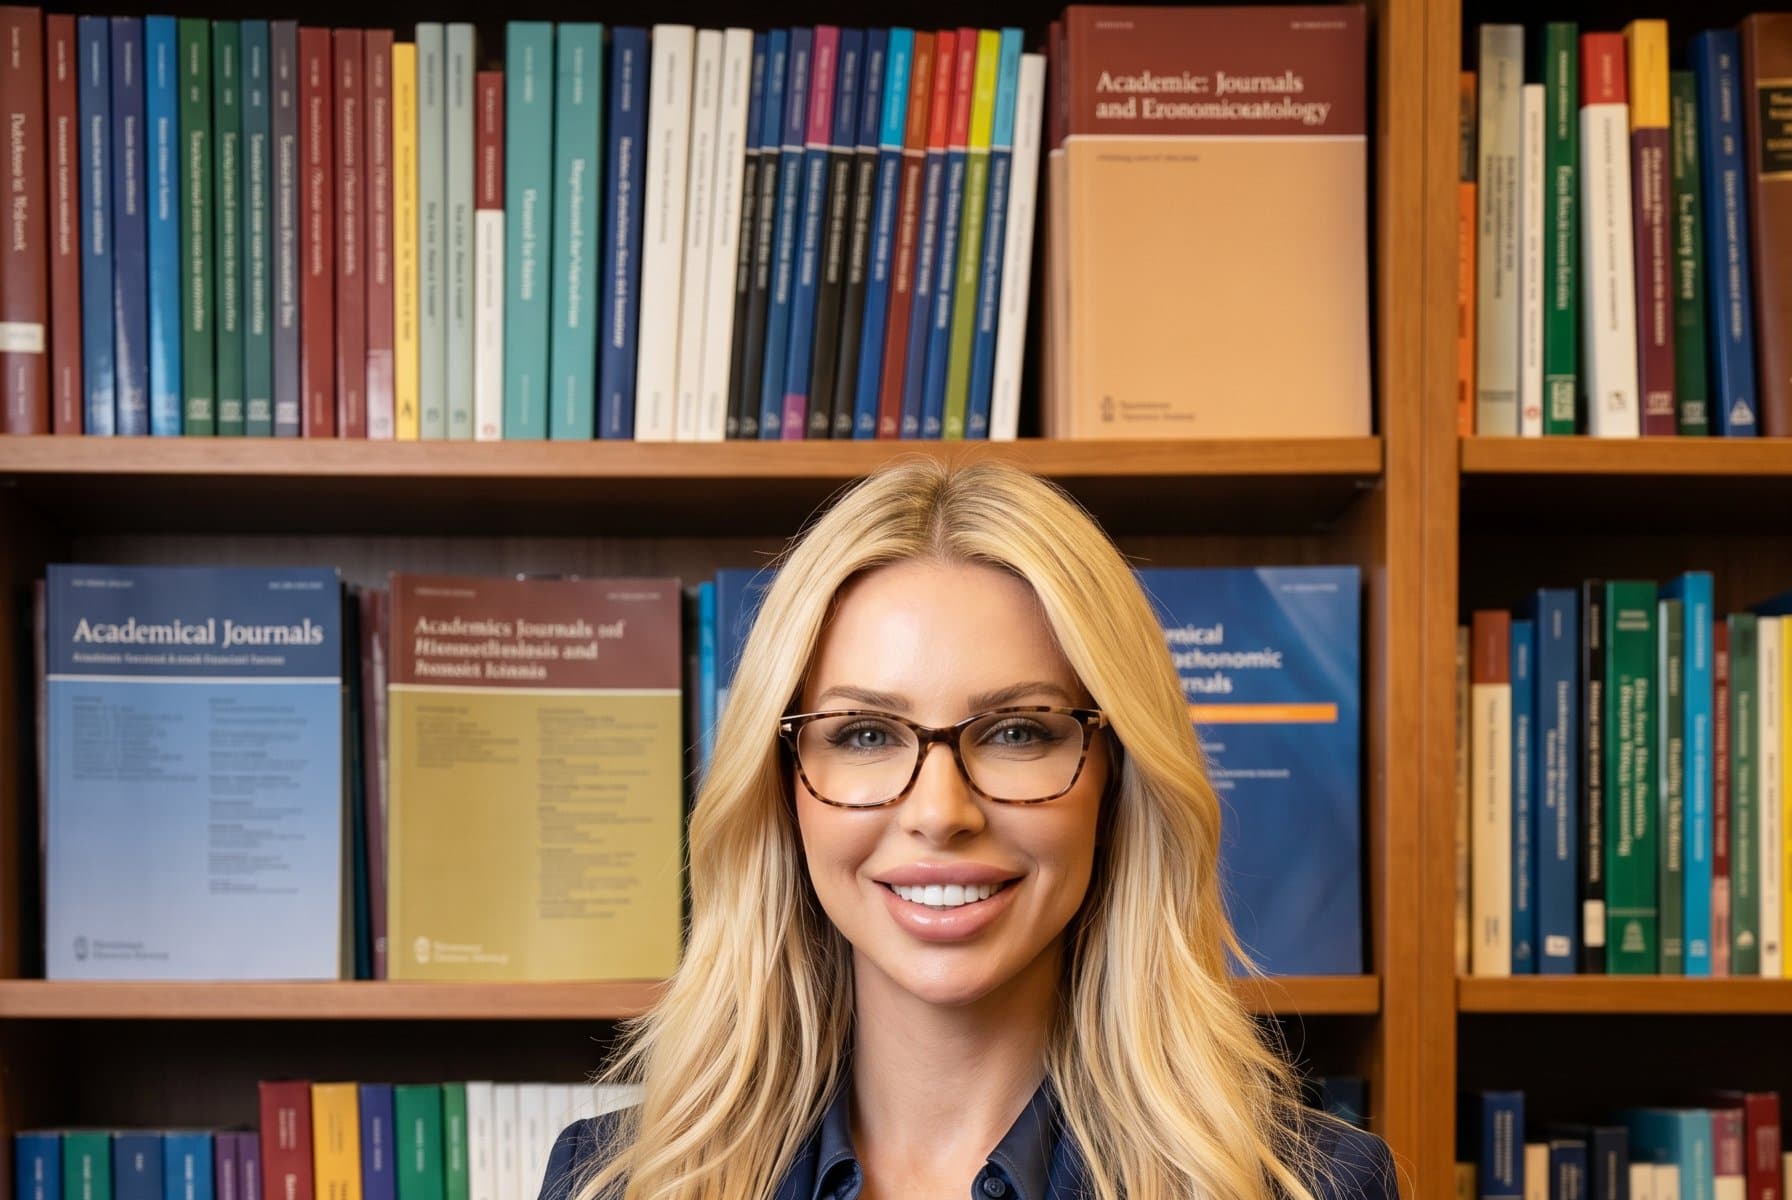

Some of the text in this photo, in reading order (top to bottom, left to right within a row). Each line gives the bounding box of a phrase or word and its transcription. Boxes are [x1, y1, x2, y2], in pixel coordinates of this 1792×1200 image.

[1215, 70, 1304, 97] Journals
[1096, 96, 1137, 119] and
[73, 616, 324, 649] Academical Journals
[516, 618, 593, 640] Journals
